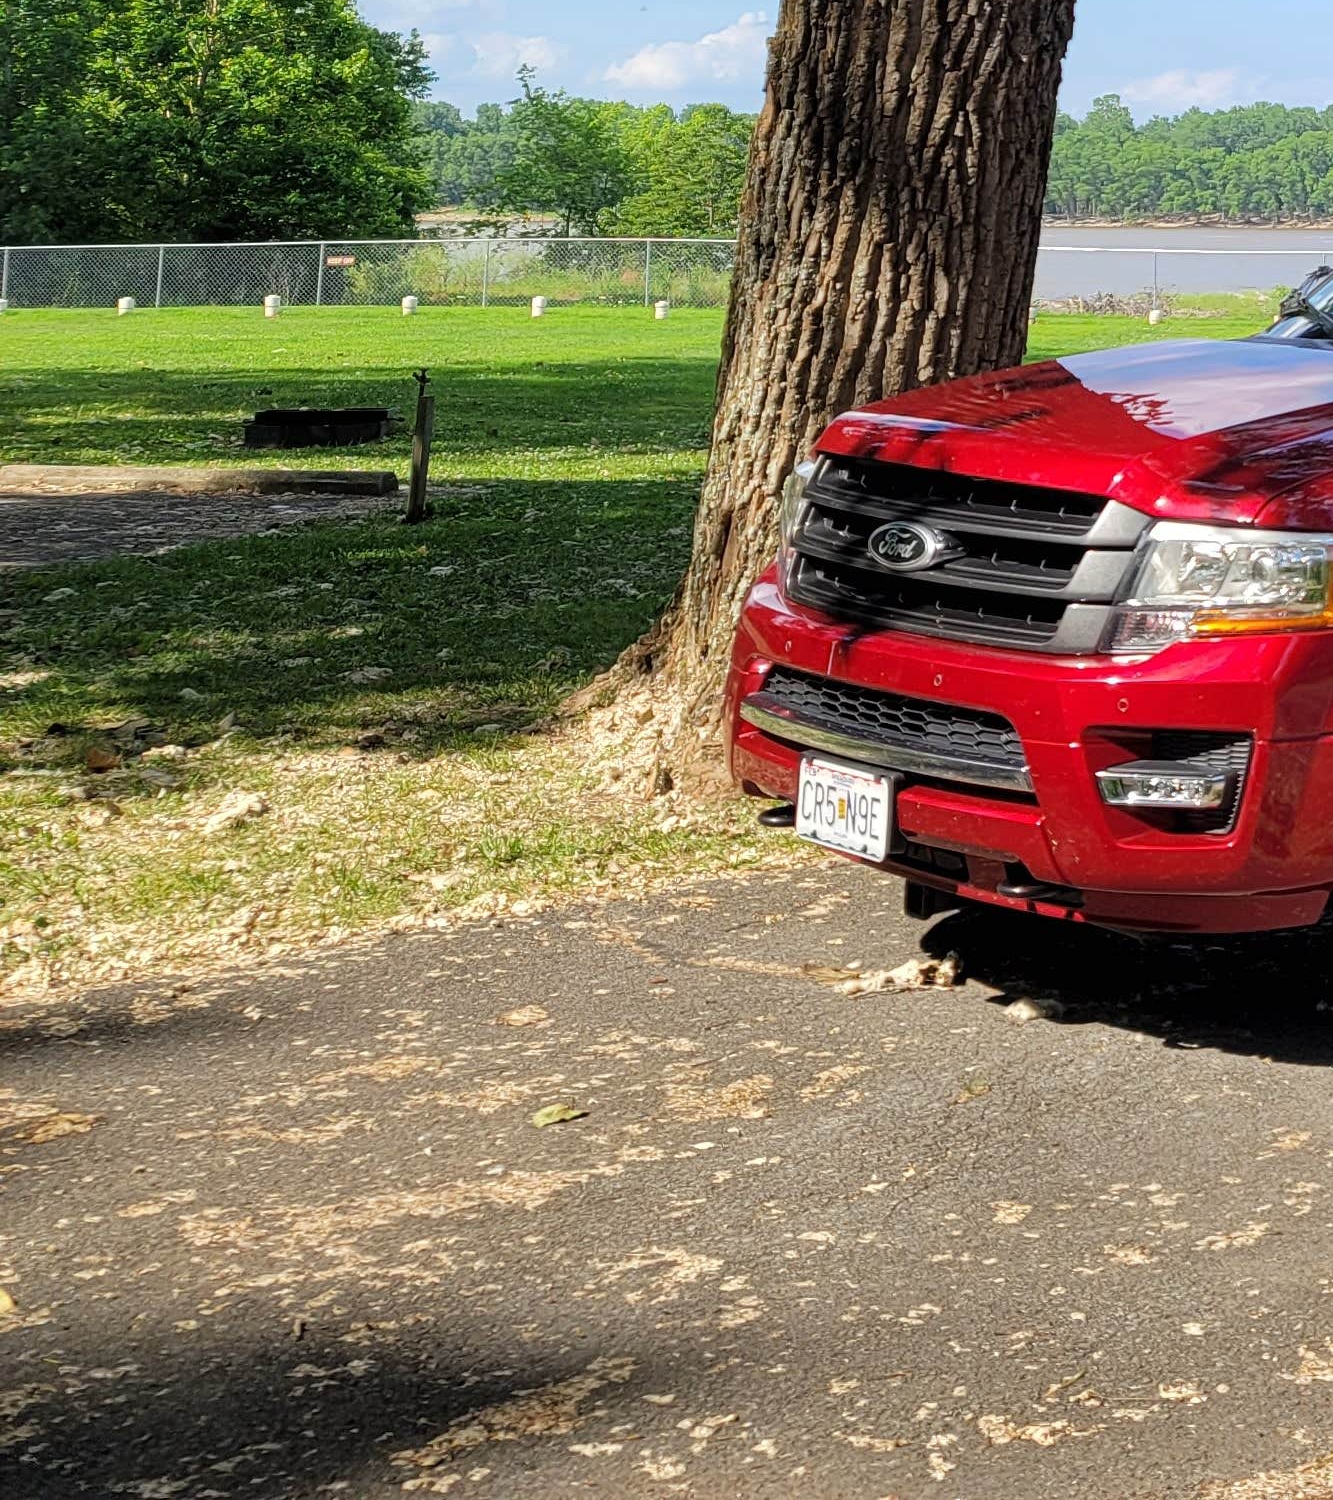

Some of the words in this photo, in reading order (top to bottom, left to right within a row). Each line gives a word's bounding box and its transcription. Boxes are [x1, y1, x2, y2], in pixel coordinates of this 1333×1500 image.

[878, 529, 918, 559] Ford
[801, 779, 837, 827] CR5
[845, 789, 881, 841] N9E
